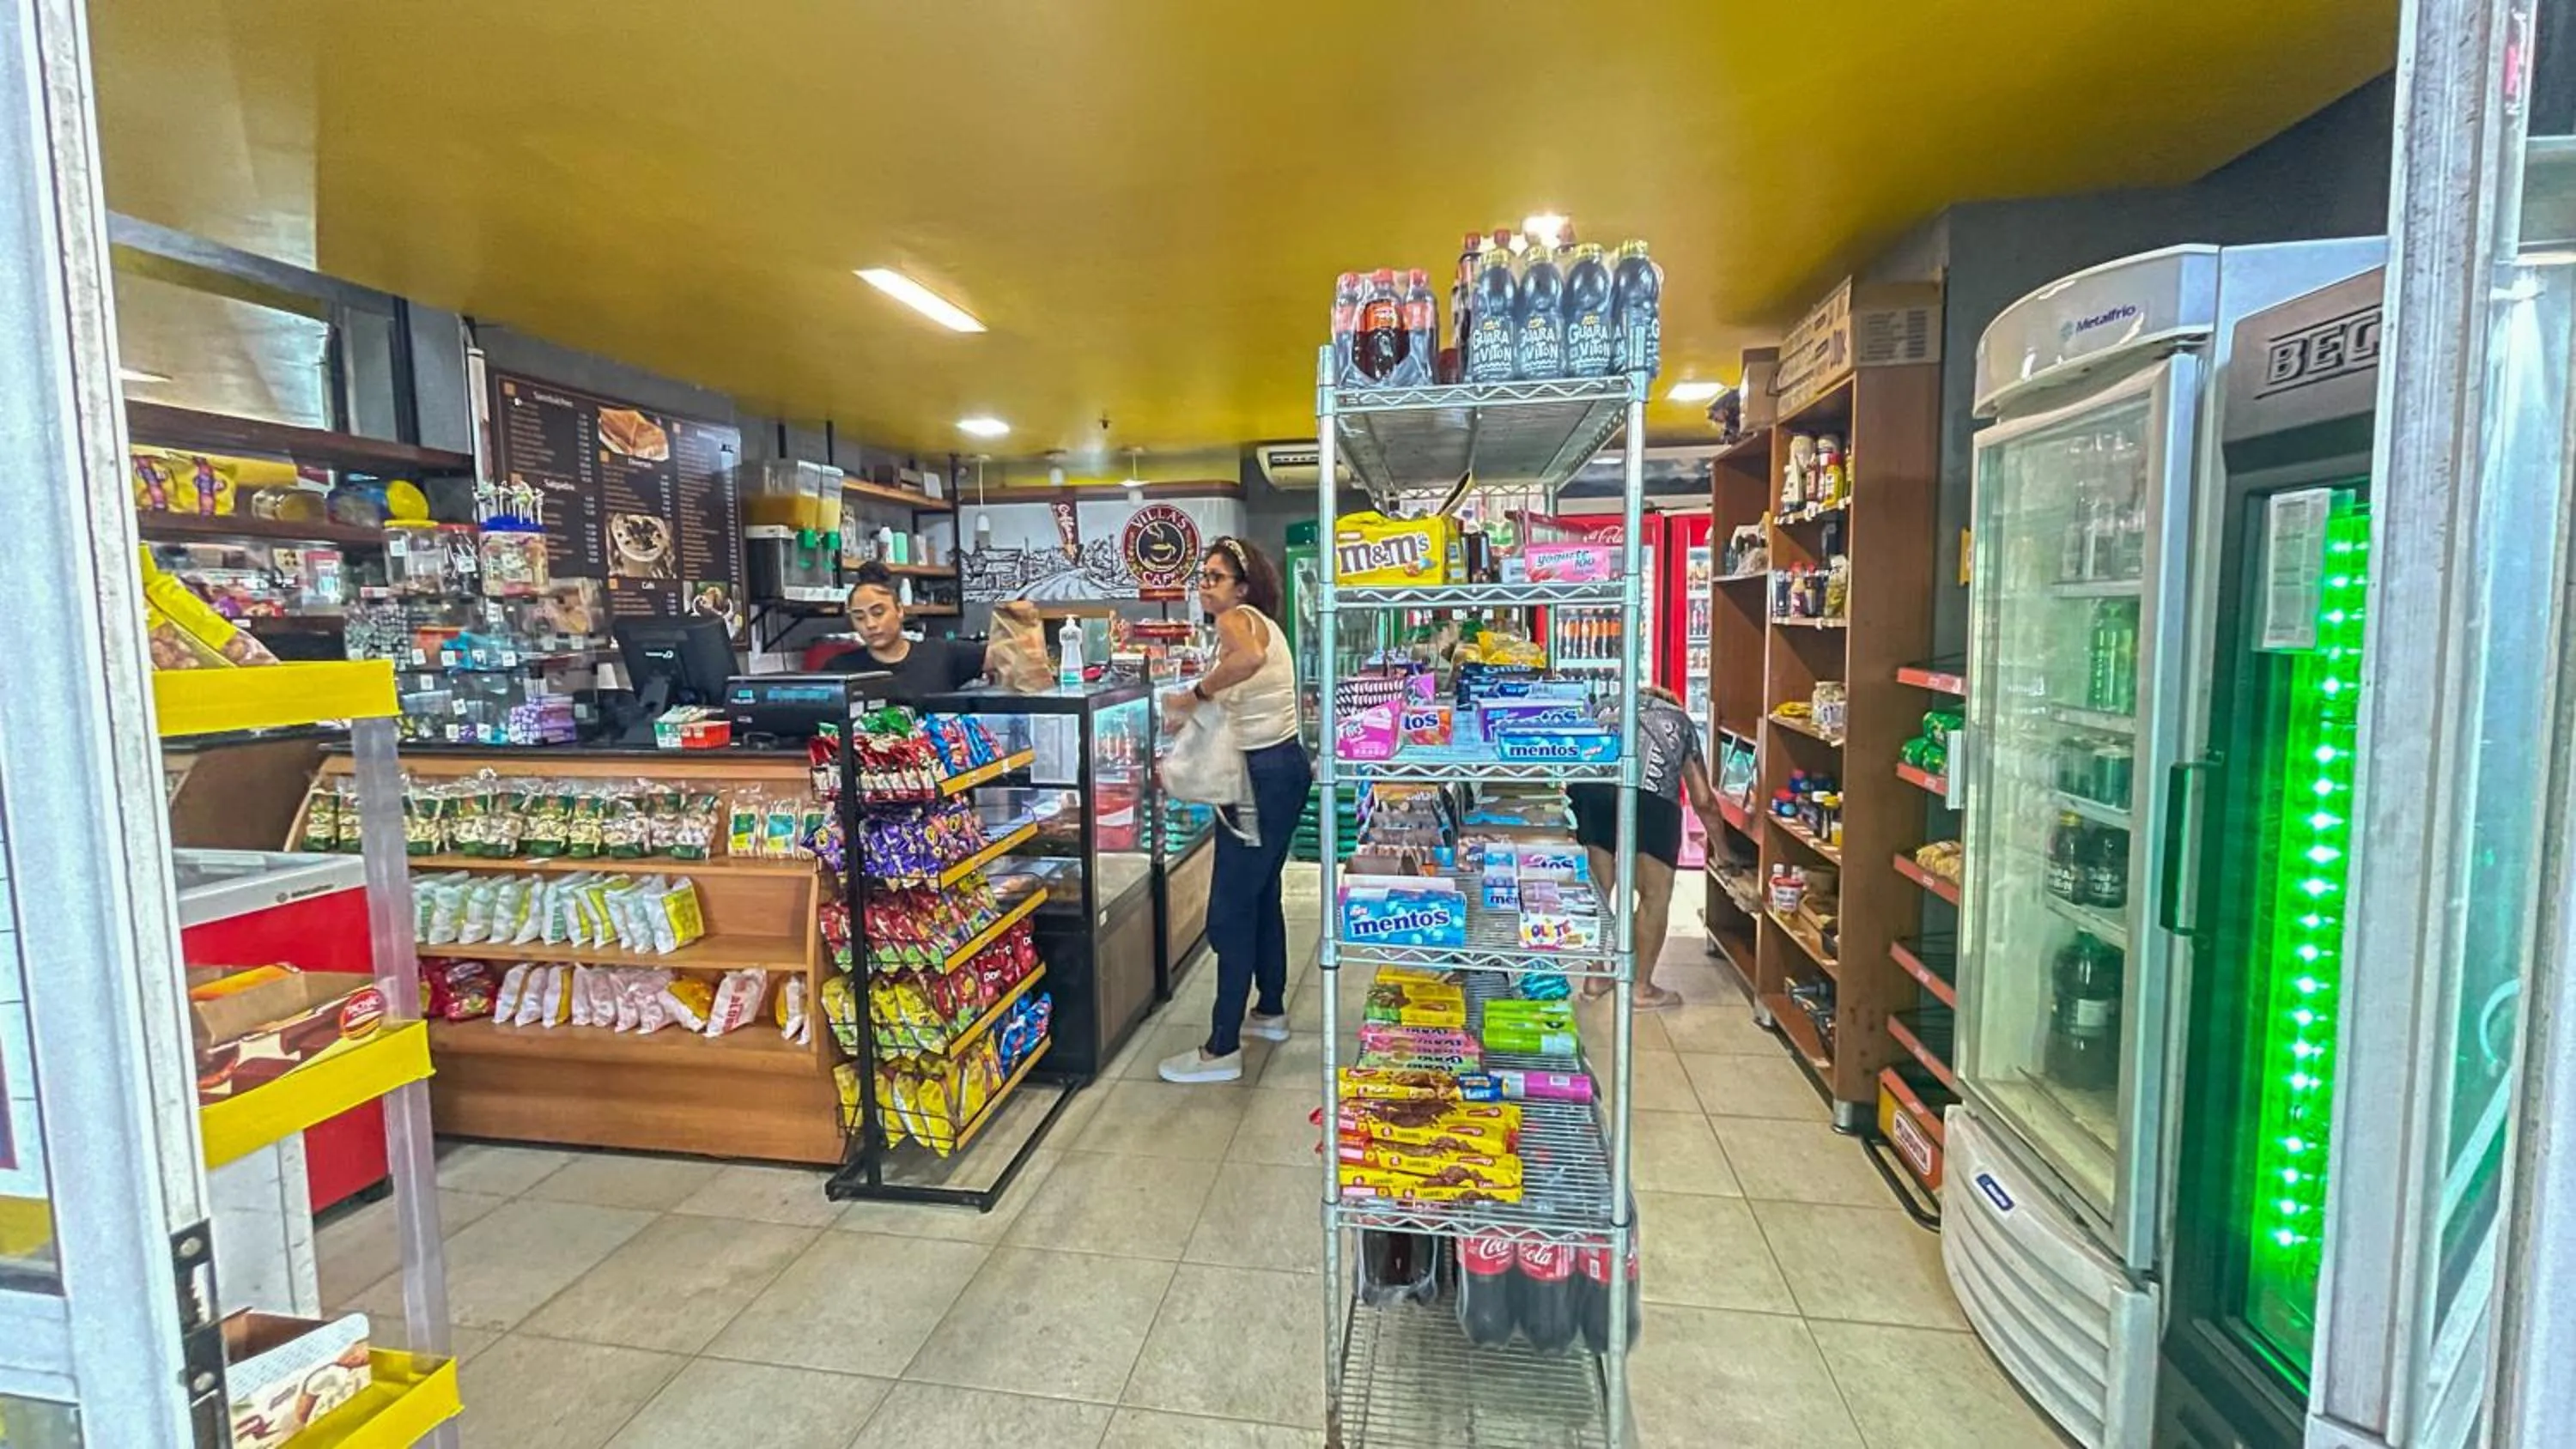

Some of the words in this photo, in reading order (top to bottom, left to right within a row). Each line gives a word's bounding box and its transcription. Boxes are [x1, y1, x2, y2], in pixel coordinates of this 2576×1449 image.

[2075, 304, 2136, 333] Metalfrio
[2267, 311, 2381, 385] BEC
[1130, 506, 1187, 530] VILLAS
[1143, 571, 1176, 585] CAF
[1509, 743, 1579, 756] mentos
[1352, 909, 1449, 935] mentos
